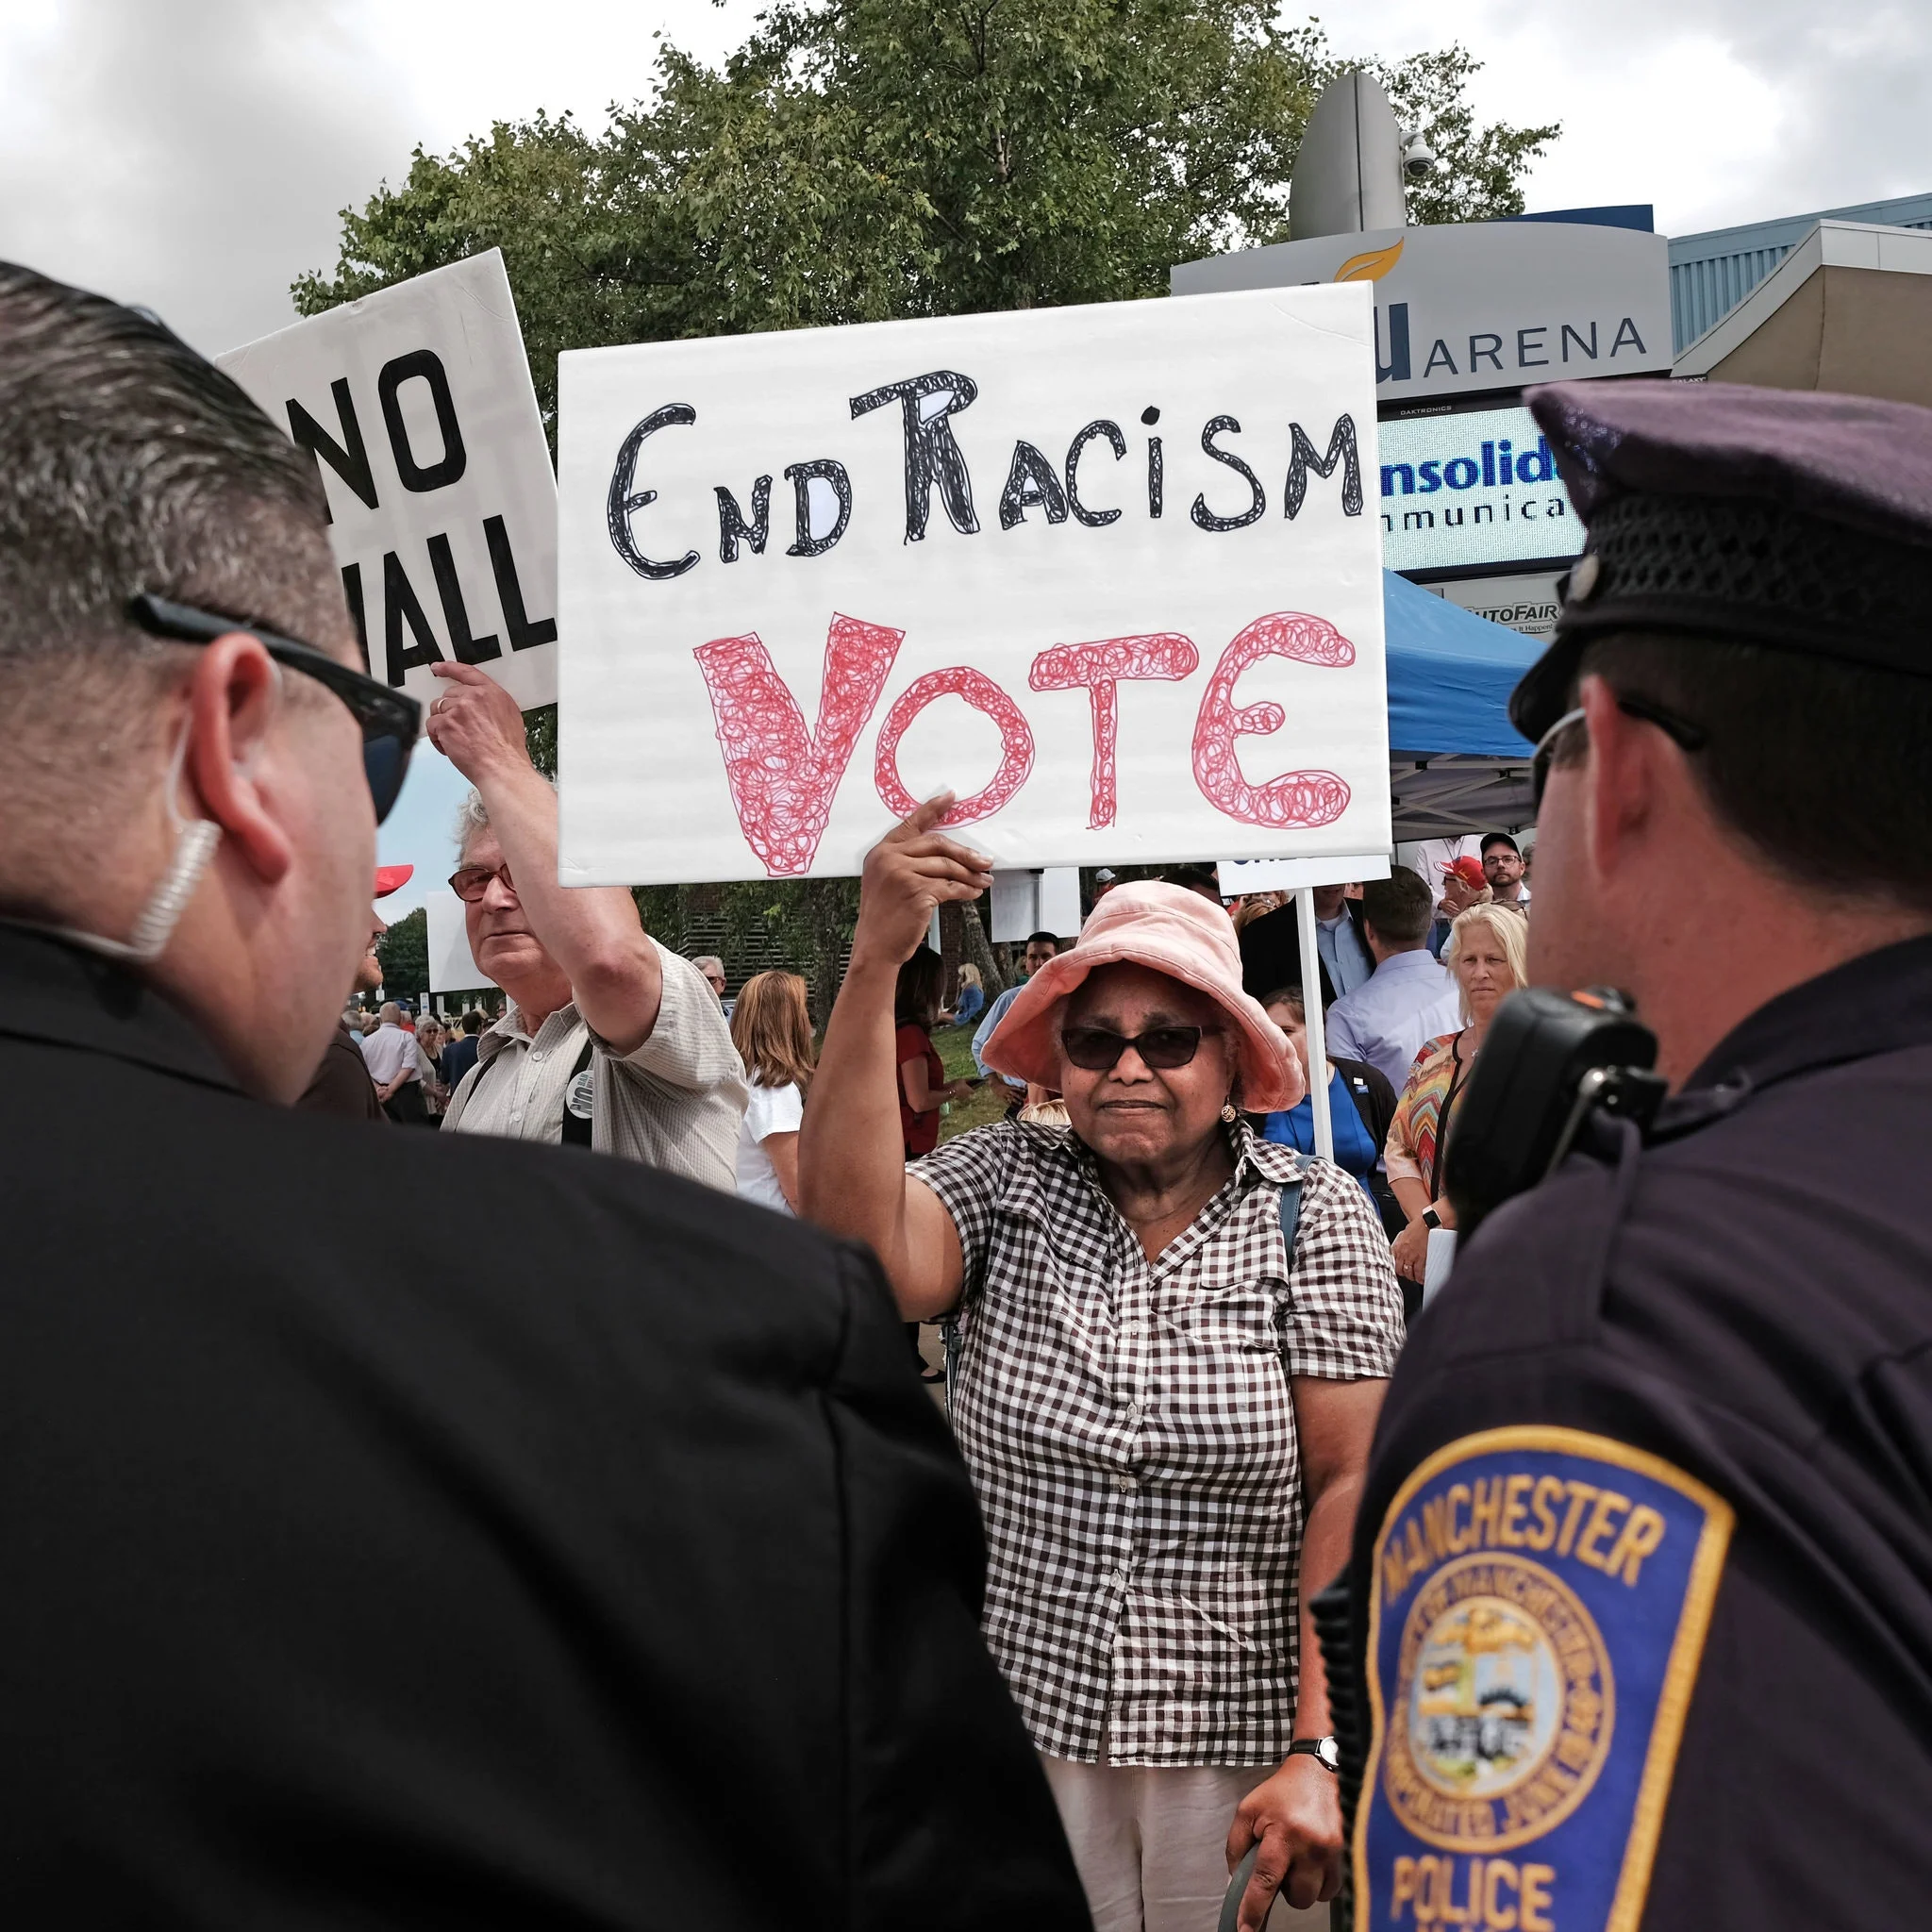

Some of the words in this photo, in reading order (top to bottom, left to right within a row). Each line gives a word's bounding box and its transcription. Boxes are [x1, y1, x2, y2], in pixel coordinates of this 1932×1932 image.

[1423, 317, 1647, 378] ARENA
[286, 349, 467, 525] NO
[1400, 406, 1452, 416] DAKTRONICS
[608, 403, 853, 579] END
[1379, 435, 1561, 497] nsolid
[341, 514, 558, 688] ALL
[1468, 604, 1558, 623] TOFAIR
[693, 611, 1357, 877] VOTE
[1384, 1474, 1666, 1603] MANCHESTER
[1391, 1855, 1556, 1932] POLICE
